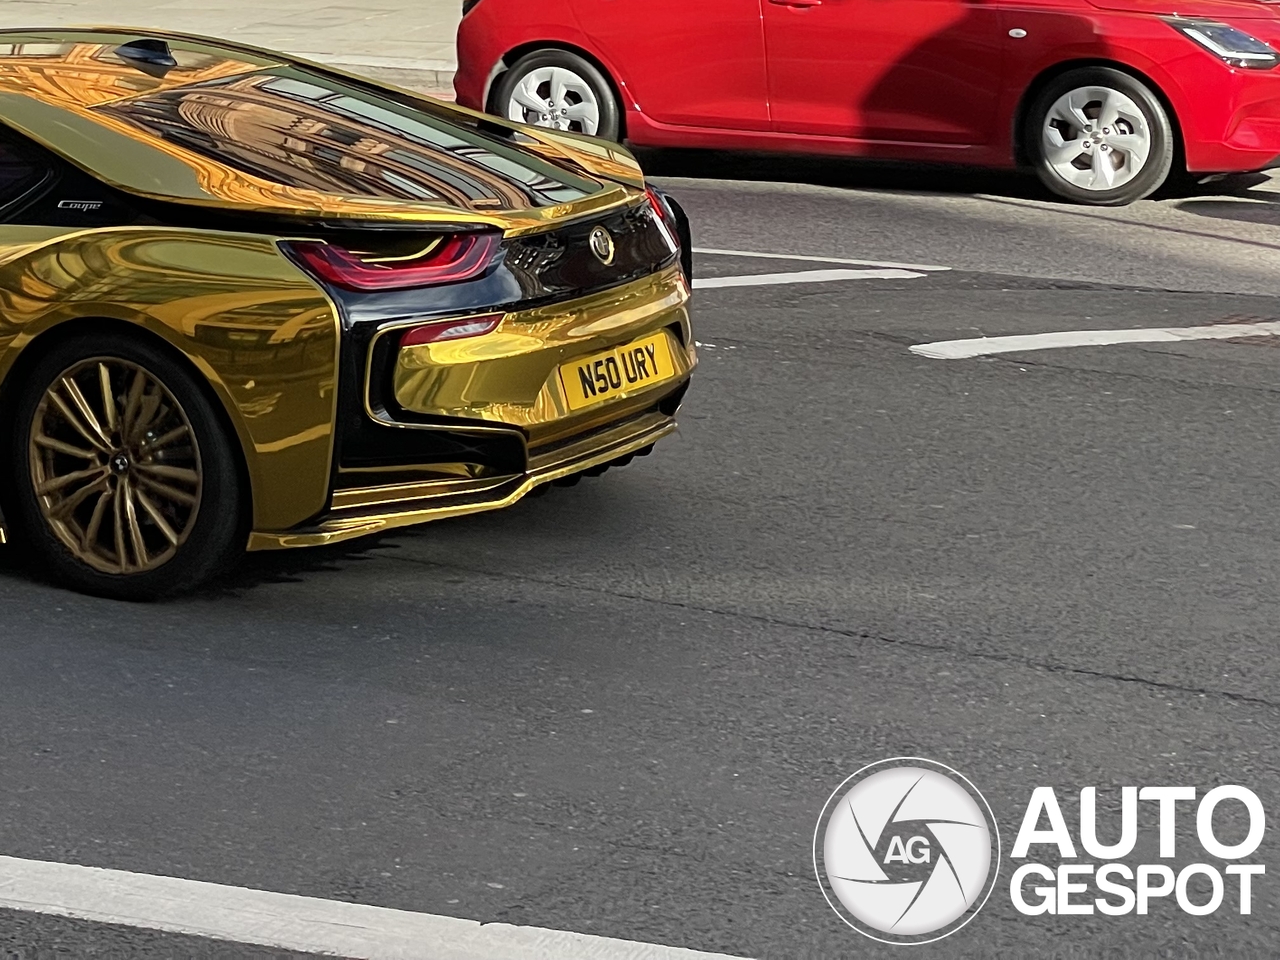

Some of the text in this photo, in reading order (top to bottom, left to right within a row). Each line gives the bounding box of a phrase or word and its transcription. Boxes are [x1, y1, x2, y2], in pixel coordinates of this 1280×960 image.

[57, 200, 103, 212] Coupe
[577, 342, 659, 399] N50 URY
